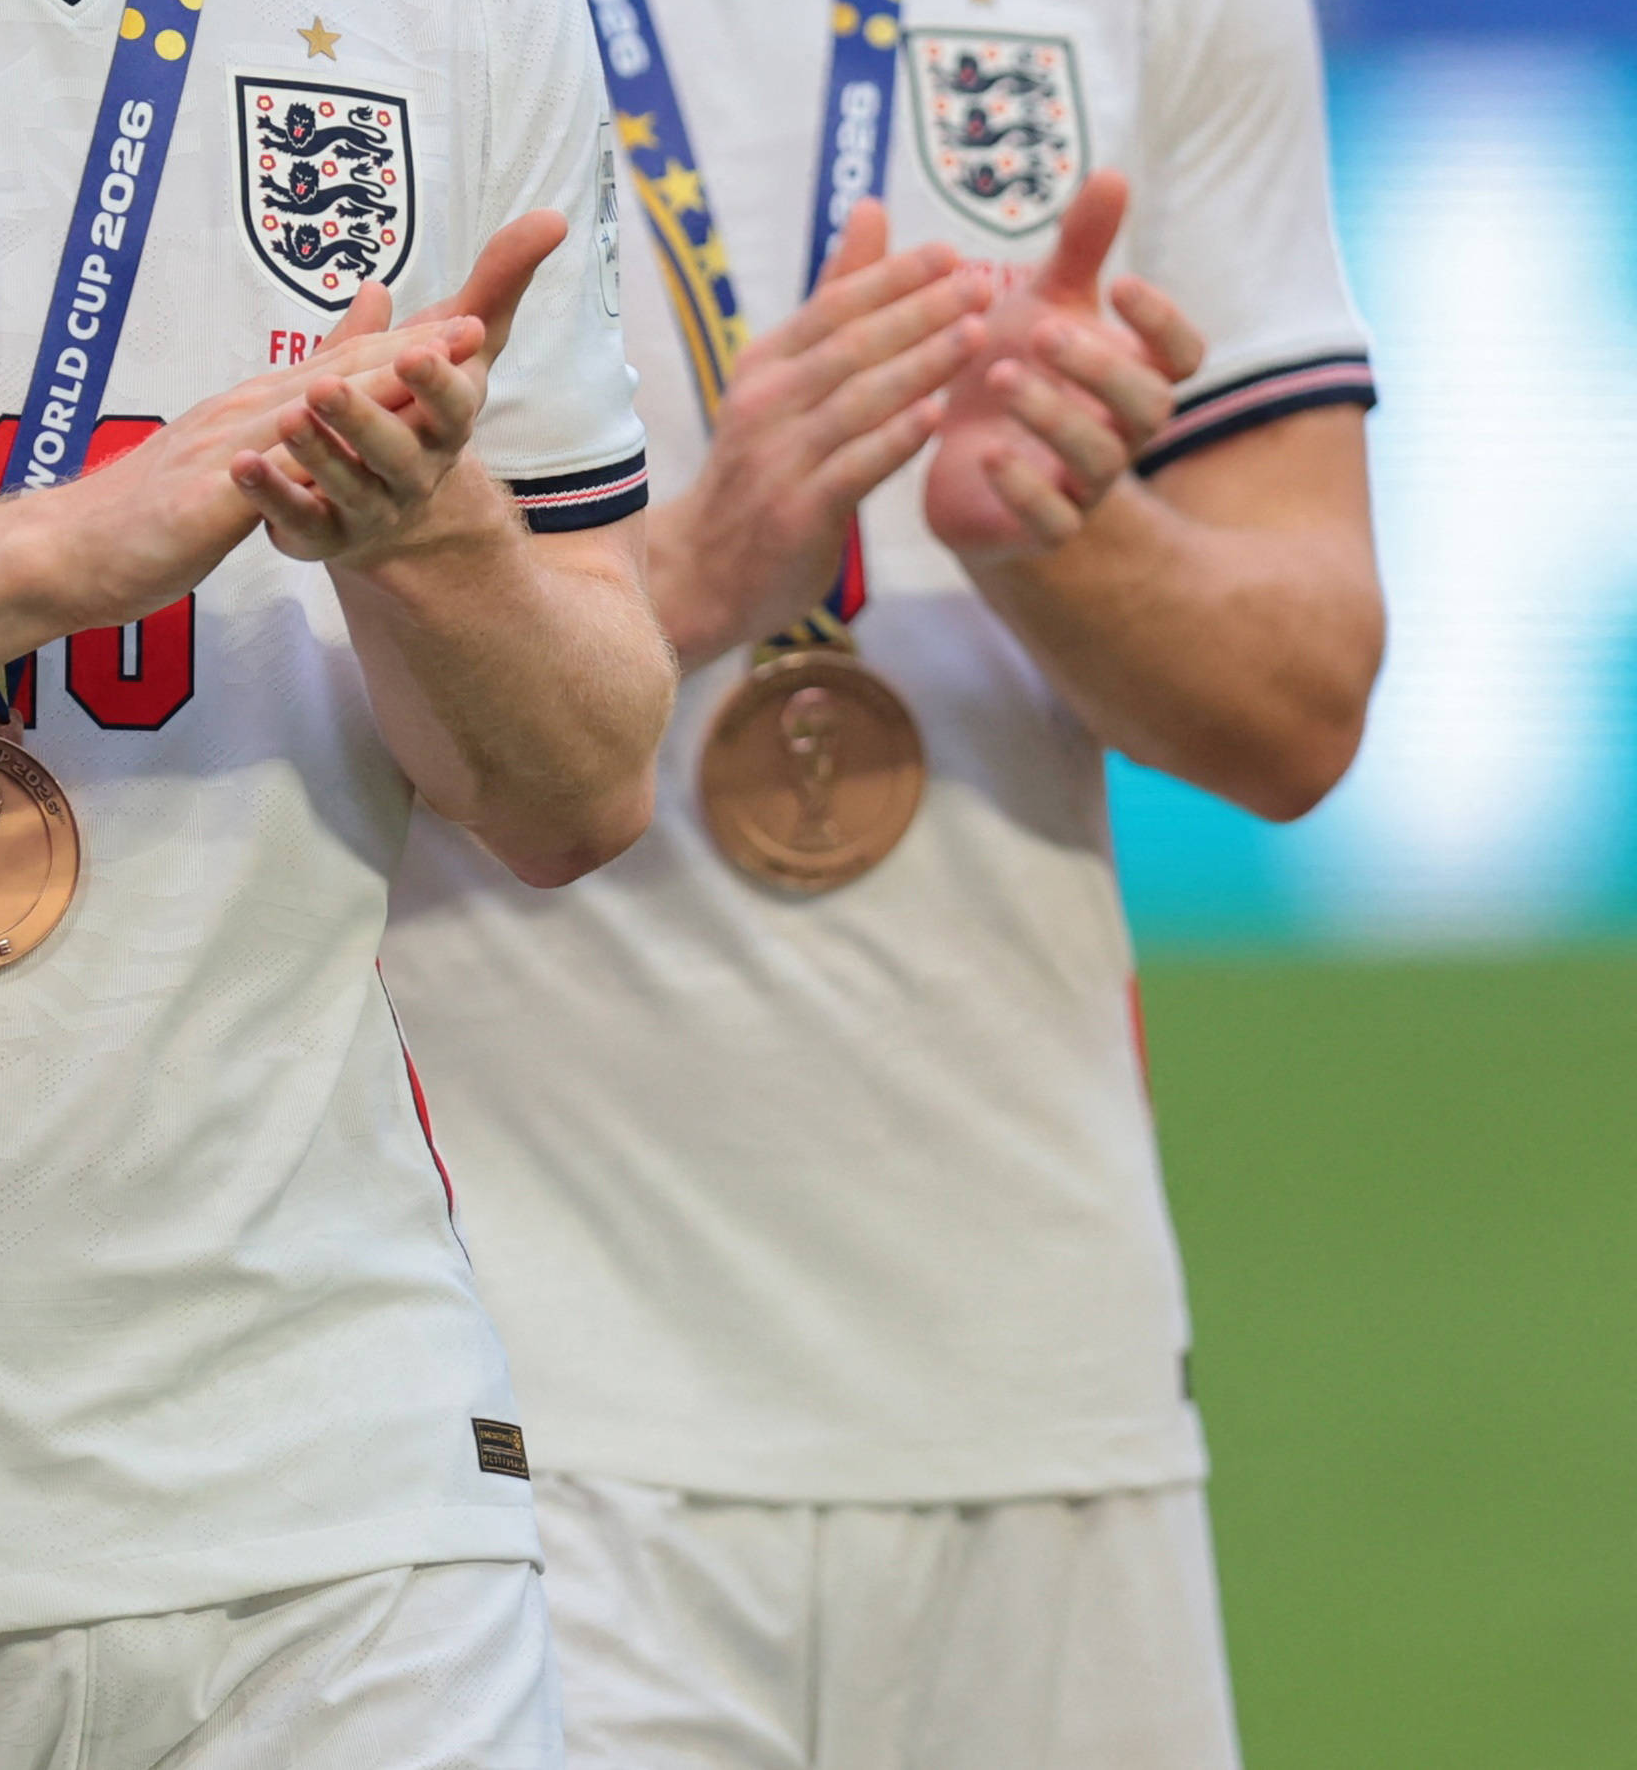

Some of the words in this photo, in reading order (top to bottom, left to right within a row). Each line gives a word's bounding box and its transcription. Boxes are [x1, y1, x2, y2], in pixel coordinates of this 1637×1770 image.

[67, 254, 113, 340] CUP
[91, 99, 155, 251] 2026
[12, 760, 60, 816] 2026
